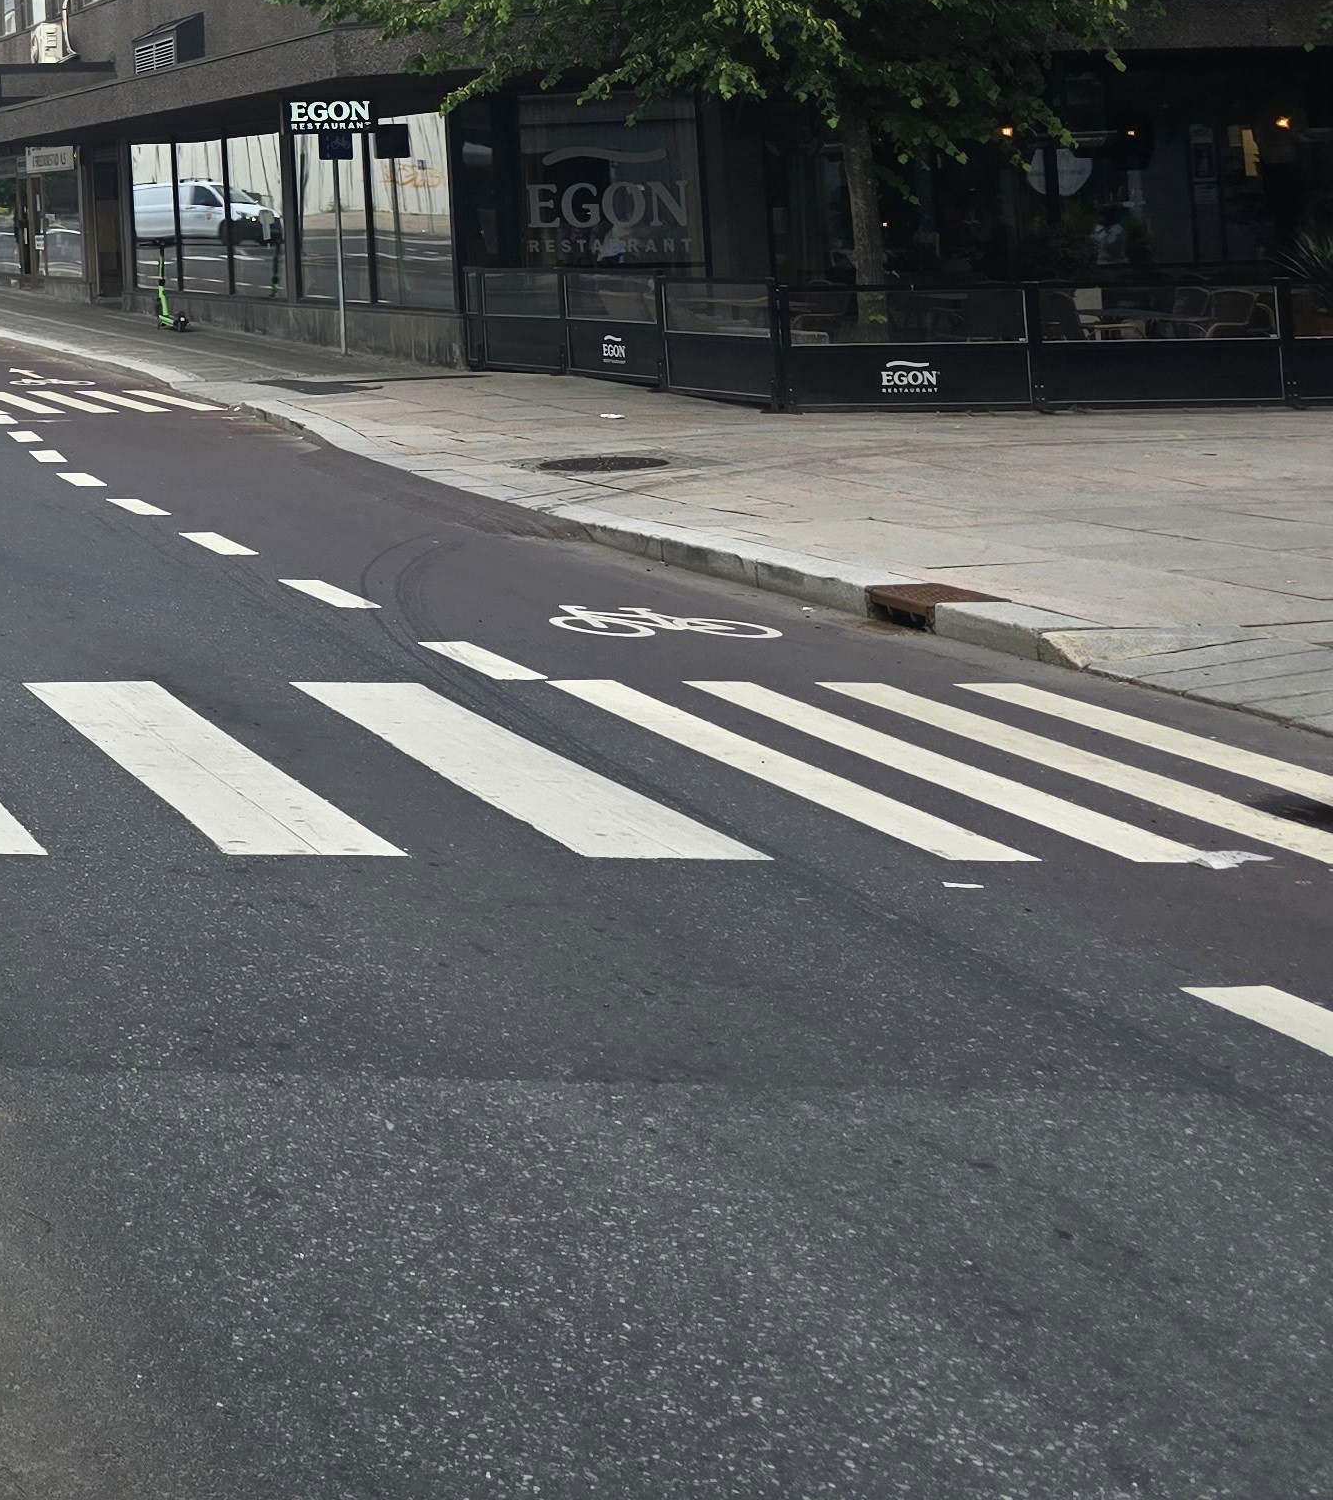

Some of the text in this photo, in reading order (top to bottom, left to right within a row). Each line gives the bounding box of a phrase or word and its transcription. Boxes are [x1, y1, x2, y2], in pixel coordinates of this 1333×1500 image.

[290, 100, 370, 122] EGON
[527, 180, 688, 228] EGON
[602, 343, 626, 358] EGON
[880, 370, 938, 386] EGON
